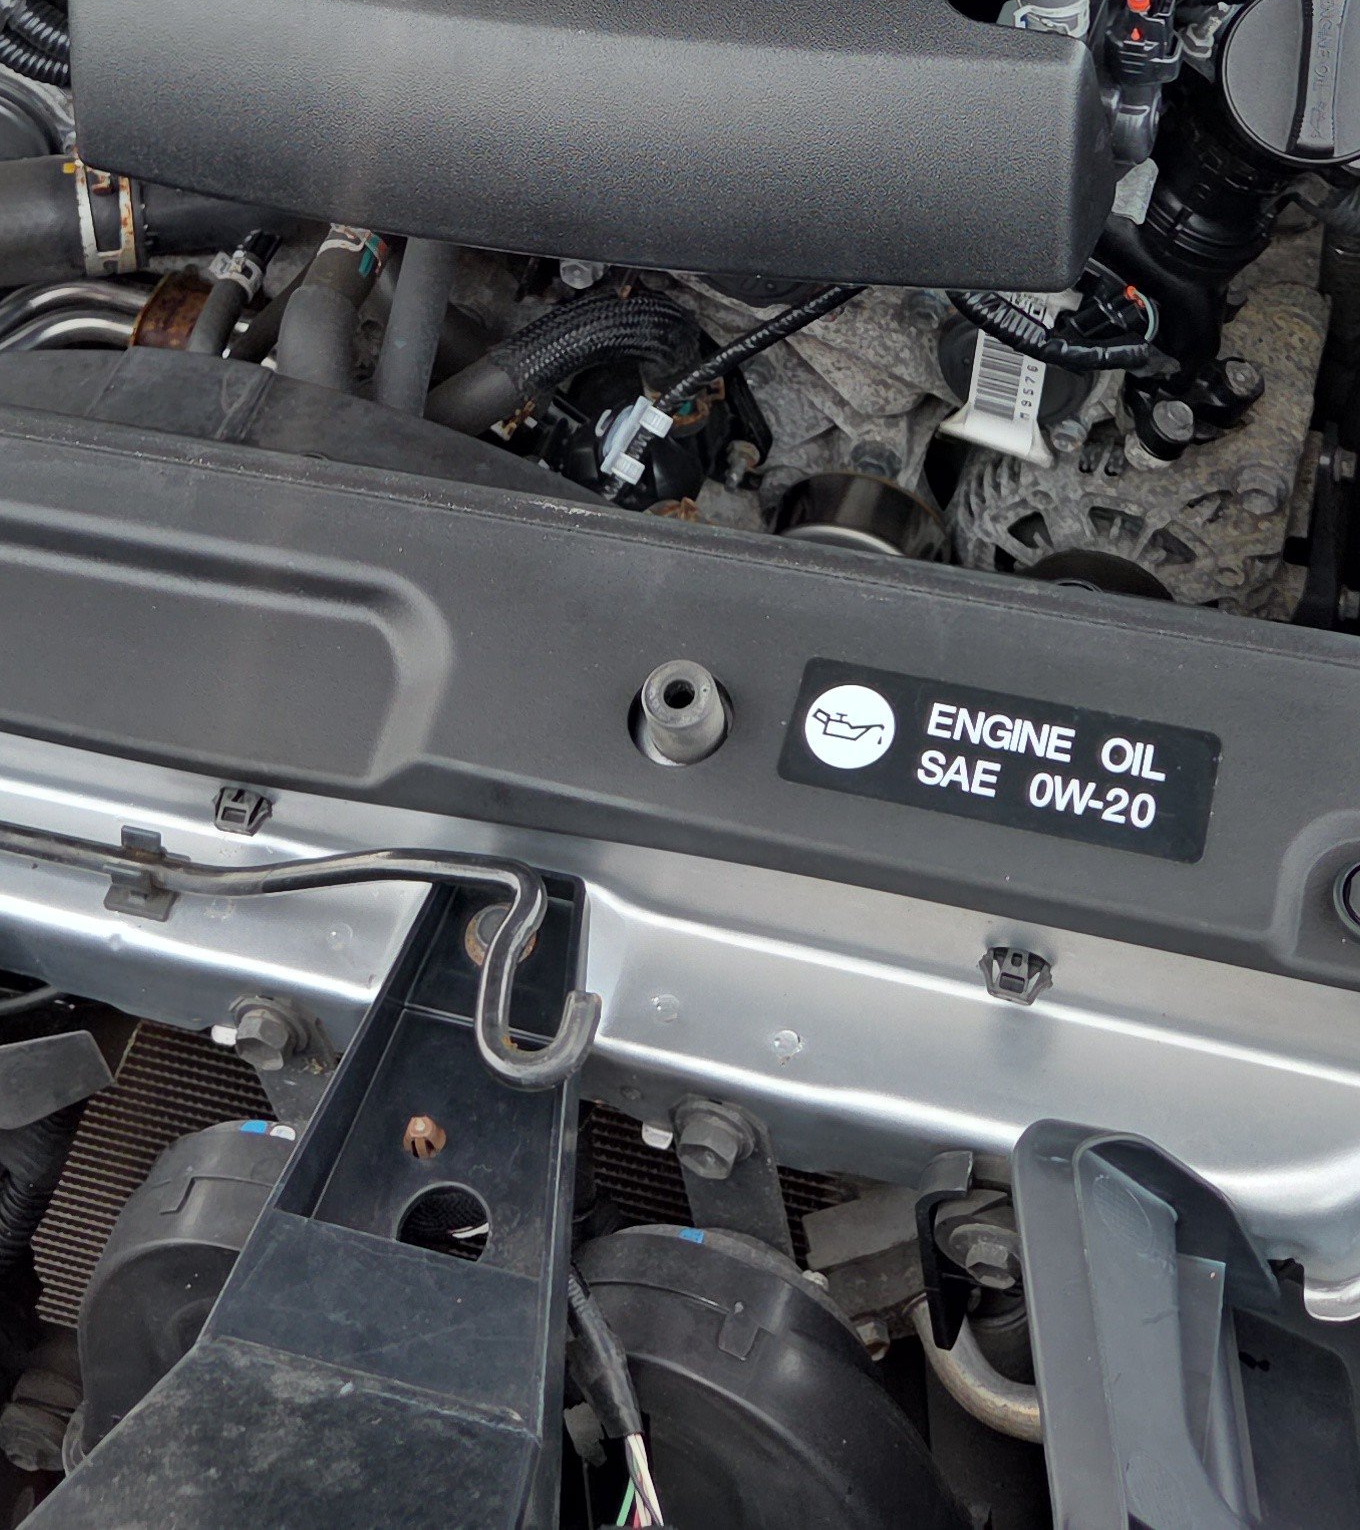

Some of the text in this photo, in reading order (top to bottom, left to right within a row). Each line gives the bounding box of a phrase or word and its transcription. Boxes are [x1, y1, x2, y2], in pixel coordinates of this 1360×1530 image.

[926, 702, 1167, 782] ENGINE OIL
[917, 750, 1156, 829] SAE 0W-20
